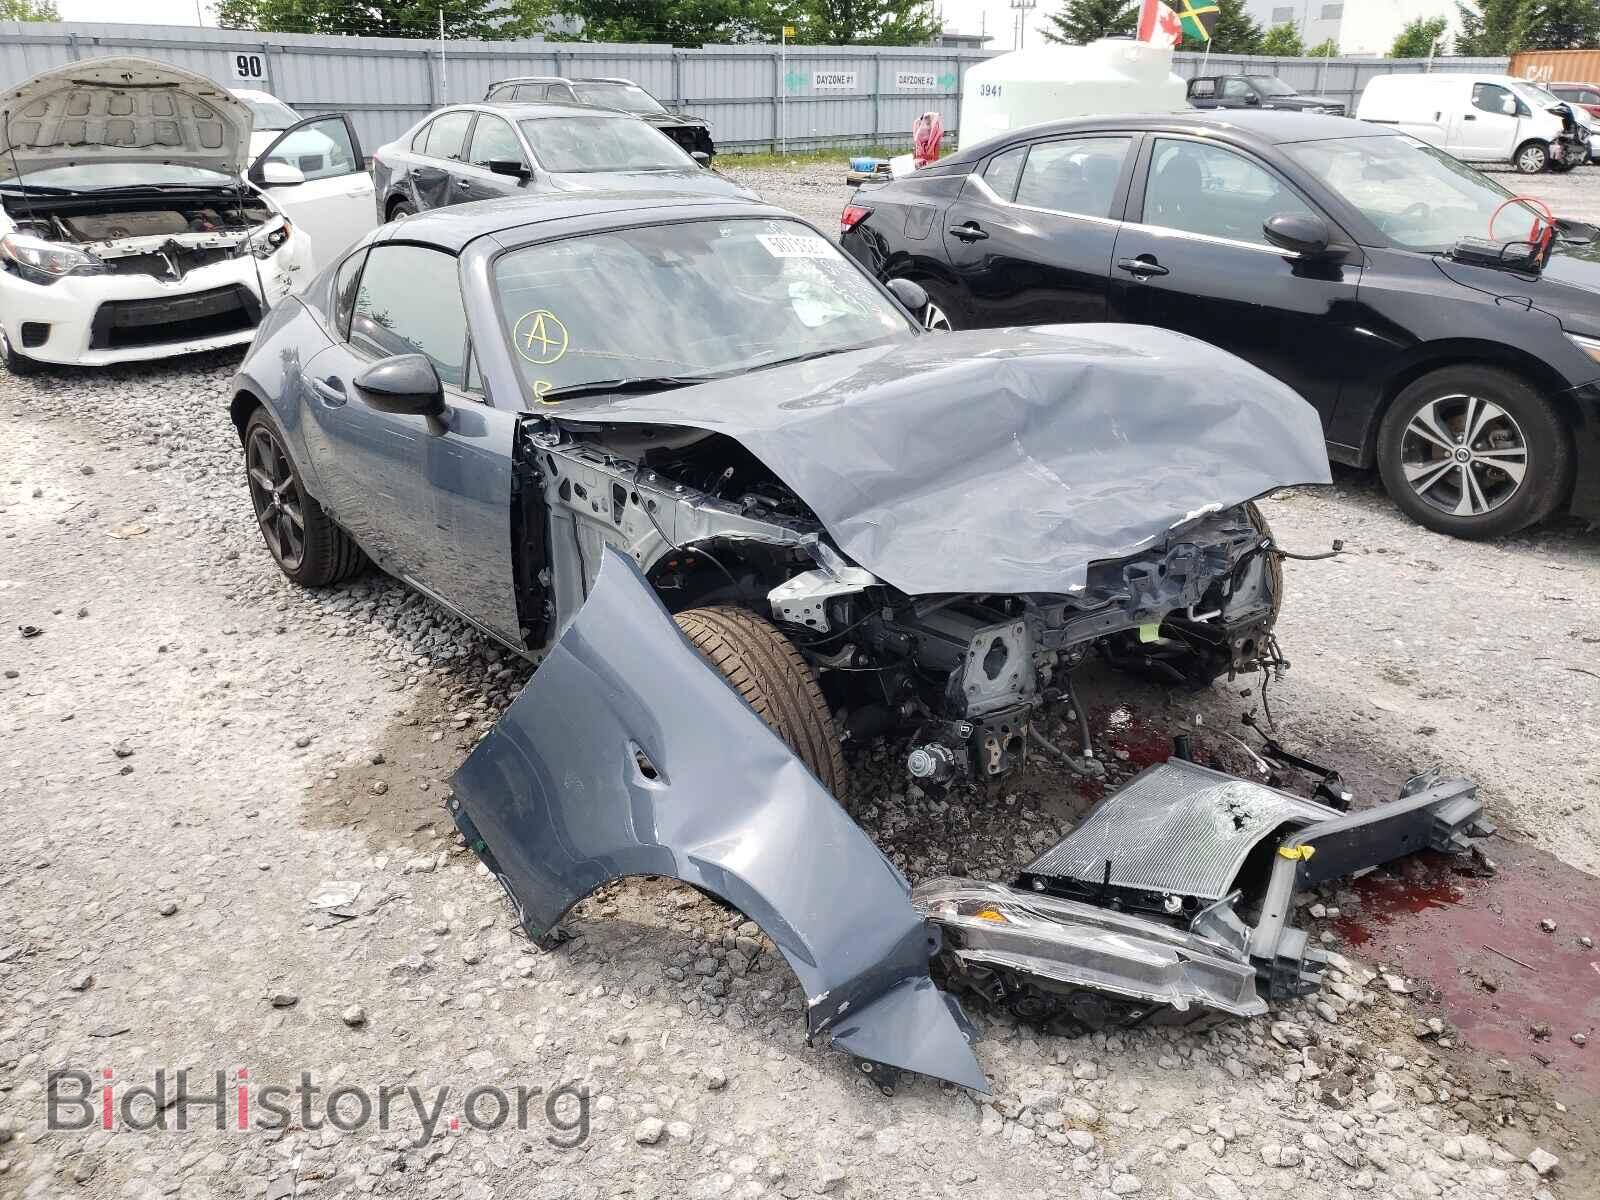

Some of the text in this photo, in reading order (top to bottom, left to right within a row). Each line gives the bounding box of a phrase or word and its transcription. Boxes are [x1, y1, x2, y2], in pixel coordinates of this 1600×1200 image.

[236, 55, 262, 77] 90
[816, 75, 854, 85] DAYZONE #1
[898, 76, 934, 85] DAYZONE #2
[980, 83, 1002, 97] 3941
[521, 312, 561, 356] A
